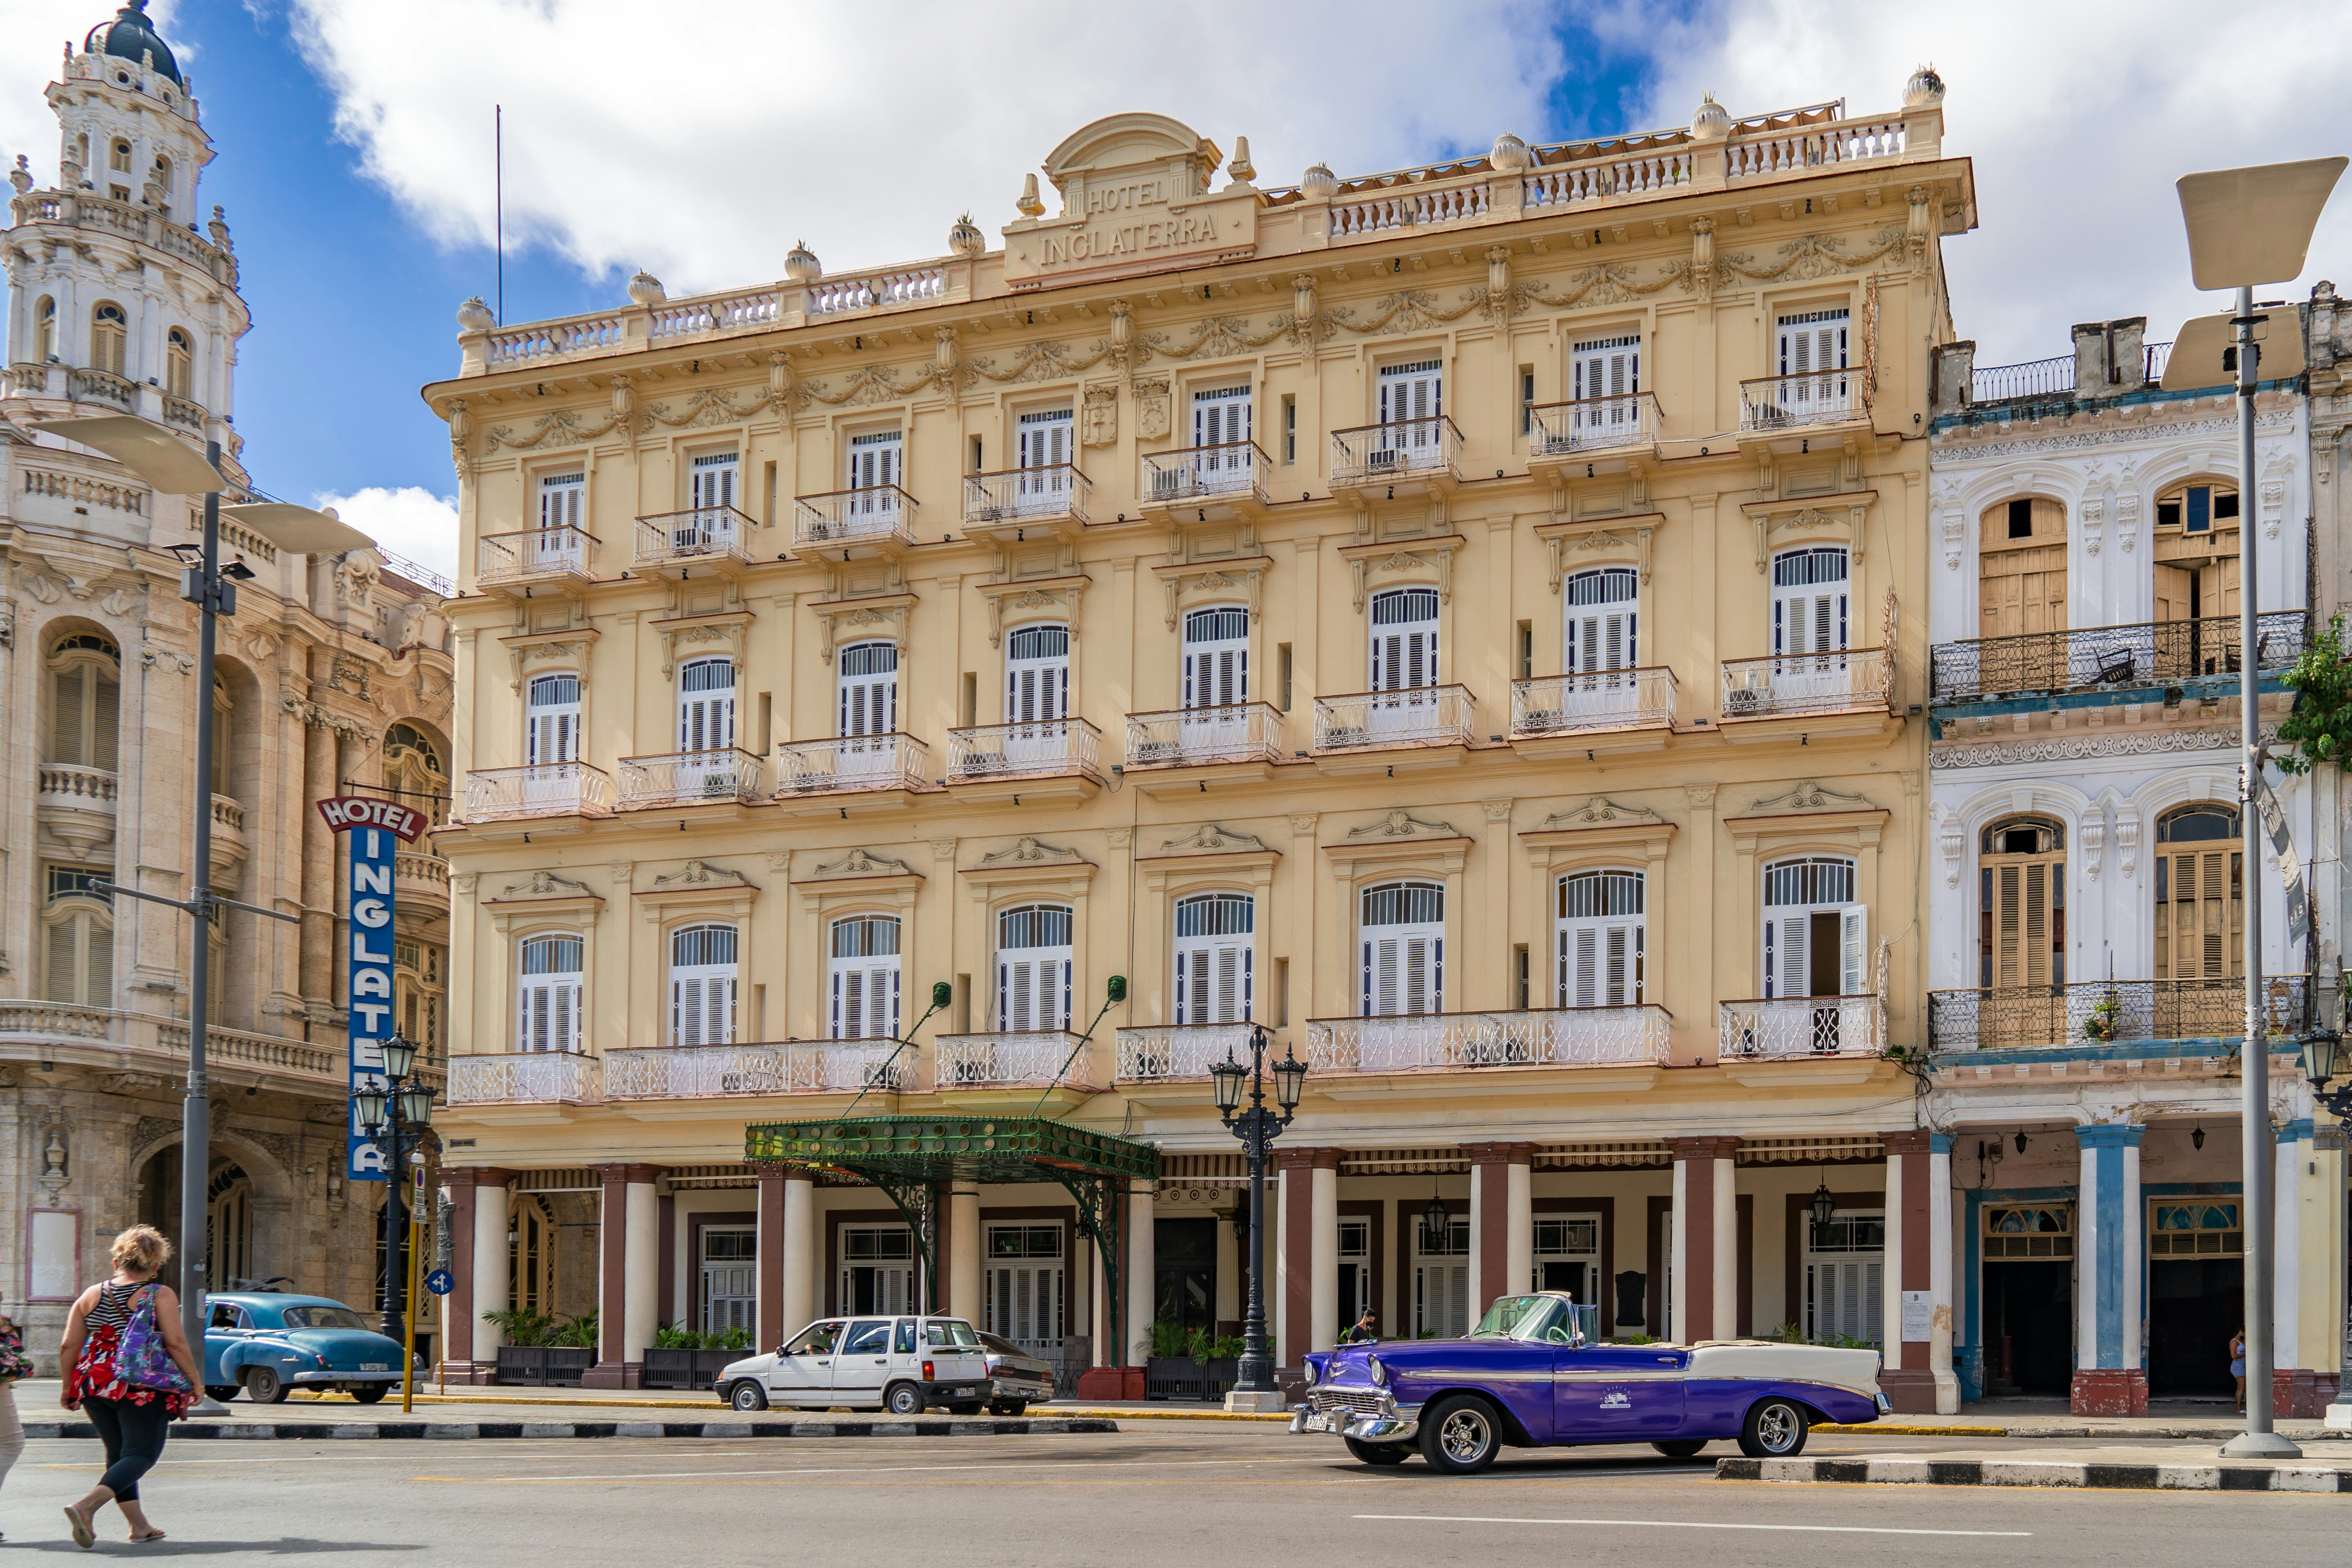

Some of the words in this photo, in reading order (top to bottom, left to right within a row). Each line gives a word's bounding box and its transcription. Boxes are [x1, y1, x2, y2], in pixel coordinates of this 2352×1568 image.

[1088, 181, 1168, 214] HOTEL
[1040, 214, 1217, 265] INGLATERRA
[322, 799, 415, 836] HOTEL
[353, 829, 390, 1172] INGLATERA
[1806, 1149, 1859, 1157] INGLATERRA
[1603, 1386, 1631, 1394] GRANCAR
